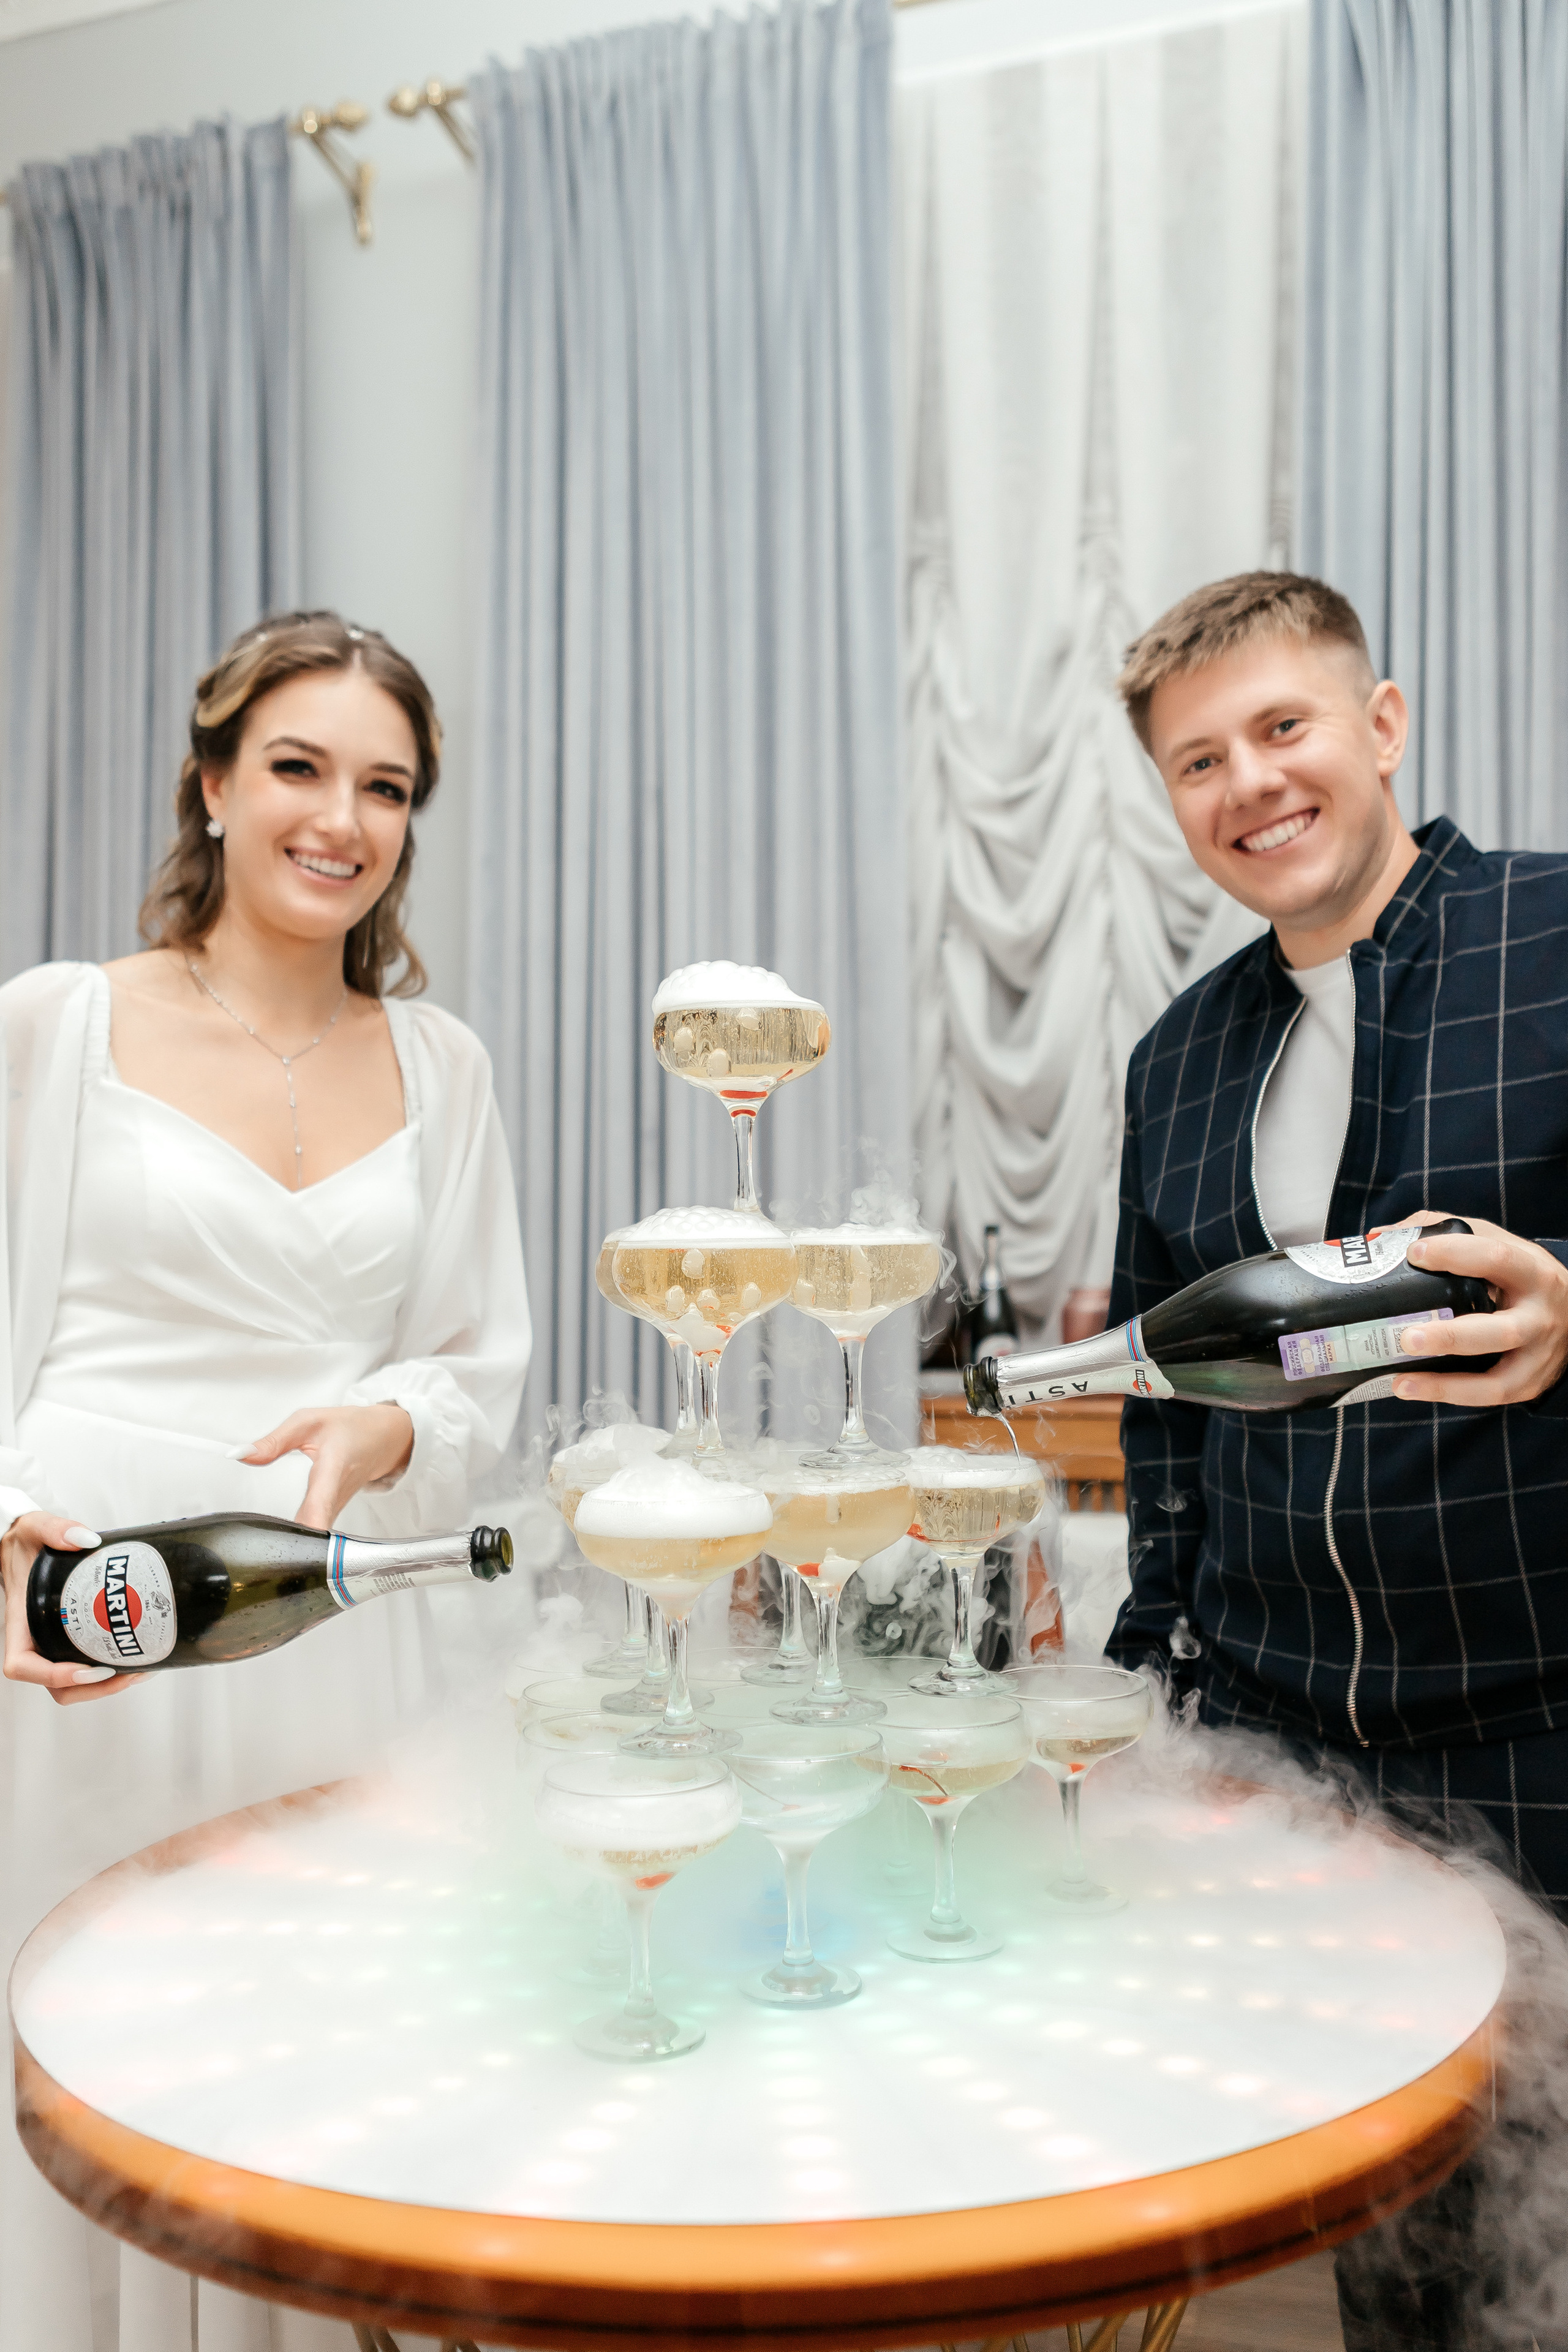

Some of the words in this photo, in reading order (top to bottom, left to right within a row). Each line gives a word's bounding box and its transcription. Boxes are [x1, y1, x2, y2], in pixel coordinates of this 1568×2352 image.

[1287, 1341, 1298, 1376] РОССИЙСКАЯ
[1292, 1340, 1302, 1376] ФЕДЕРАЦИЯ
[1314, 1335, 1325, 1373] ФЕДЕРАЛЬНАЯ
[1319, 1334, 1330, 1372] СПЕЦИАЛЬНАЯ
[1008, 1381, 1088, 1405] ASTI
[70, 1597, 81, 1632] ASTI
[106, 1557, 140, 1654] MARTINI
